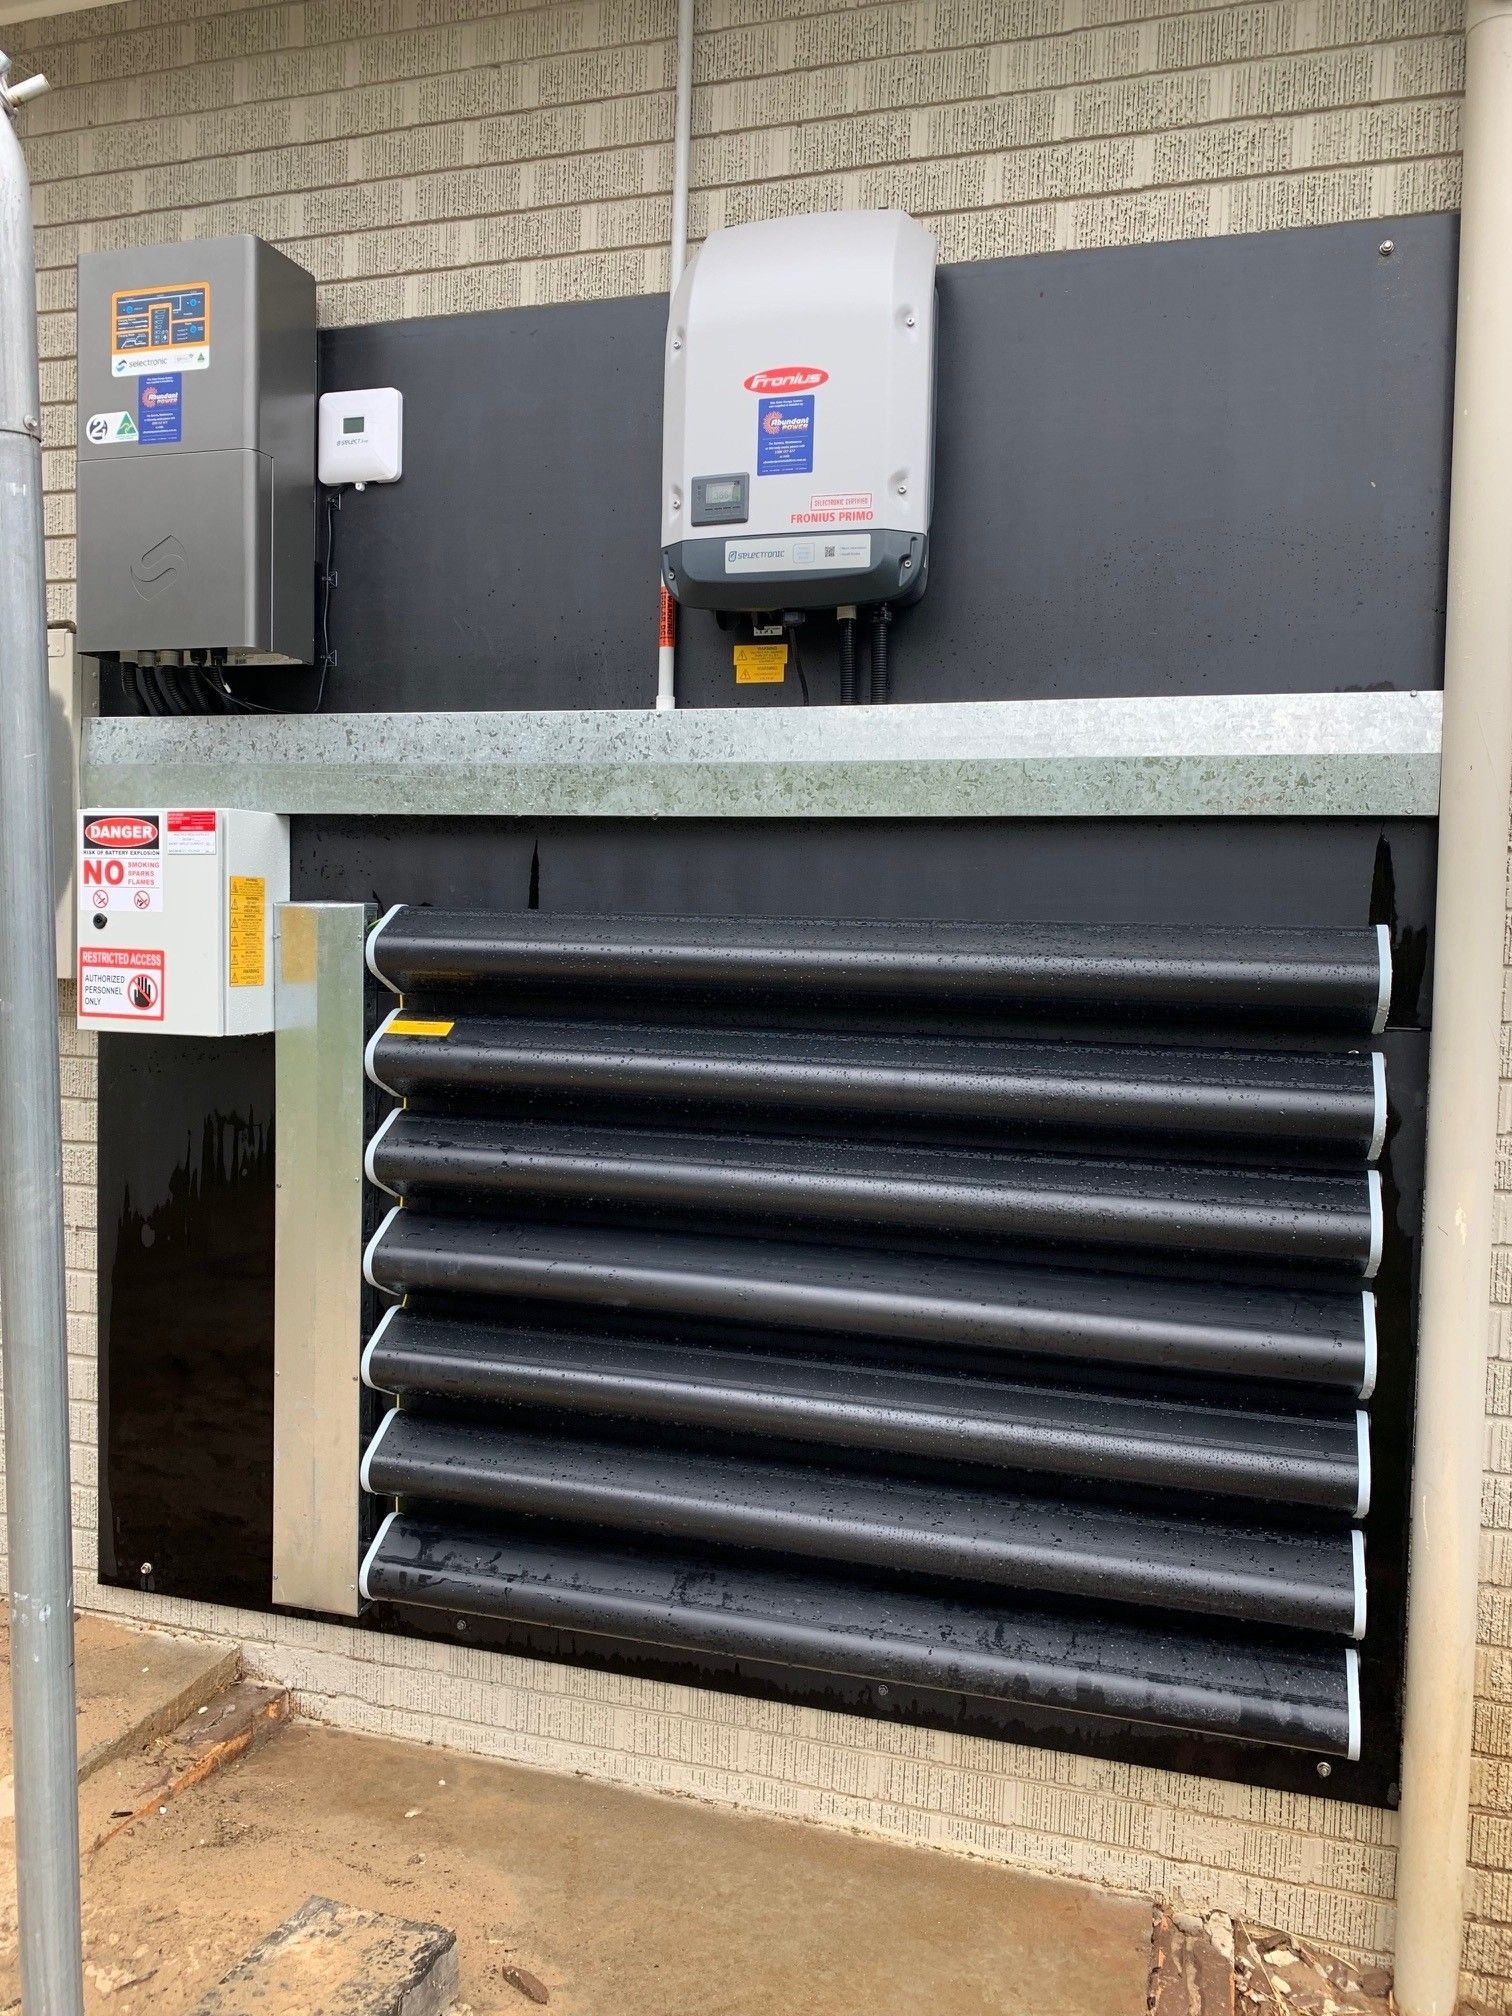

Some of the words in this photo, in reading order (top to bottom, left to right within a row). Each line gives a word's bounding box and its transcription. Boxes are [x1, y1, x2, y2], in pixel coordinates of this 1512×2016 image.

[128, 358, 167, 368] selectronic
[750, 373, 821, 389] Fronius
[771, 417, 809, 427] Abundant
[791, 512, 835, 523] FRONIUS
[839, 511, 873, 521] PRIMO
[90, 825, 152, 839] DANGER
[84, 860, 124, 885] NO
[82, 951, 129, 965] RESTRICTED
[130, 953, 161, 967] ACCESS
[85, 974, 125, 983] AUTHORIZED
[85, 985, 123, 995] PERSONNEL
[85, 997, 101, 1005] ONLY
